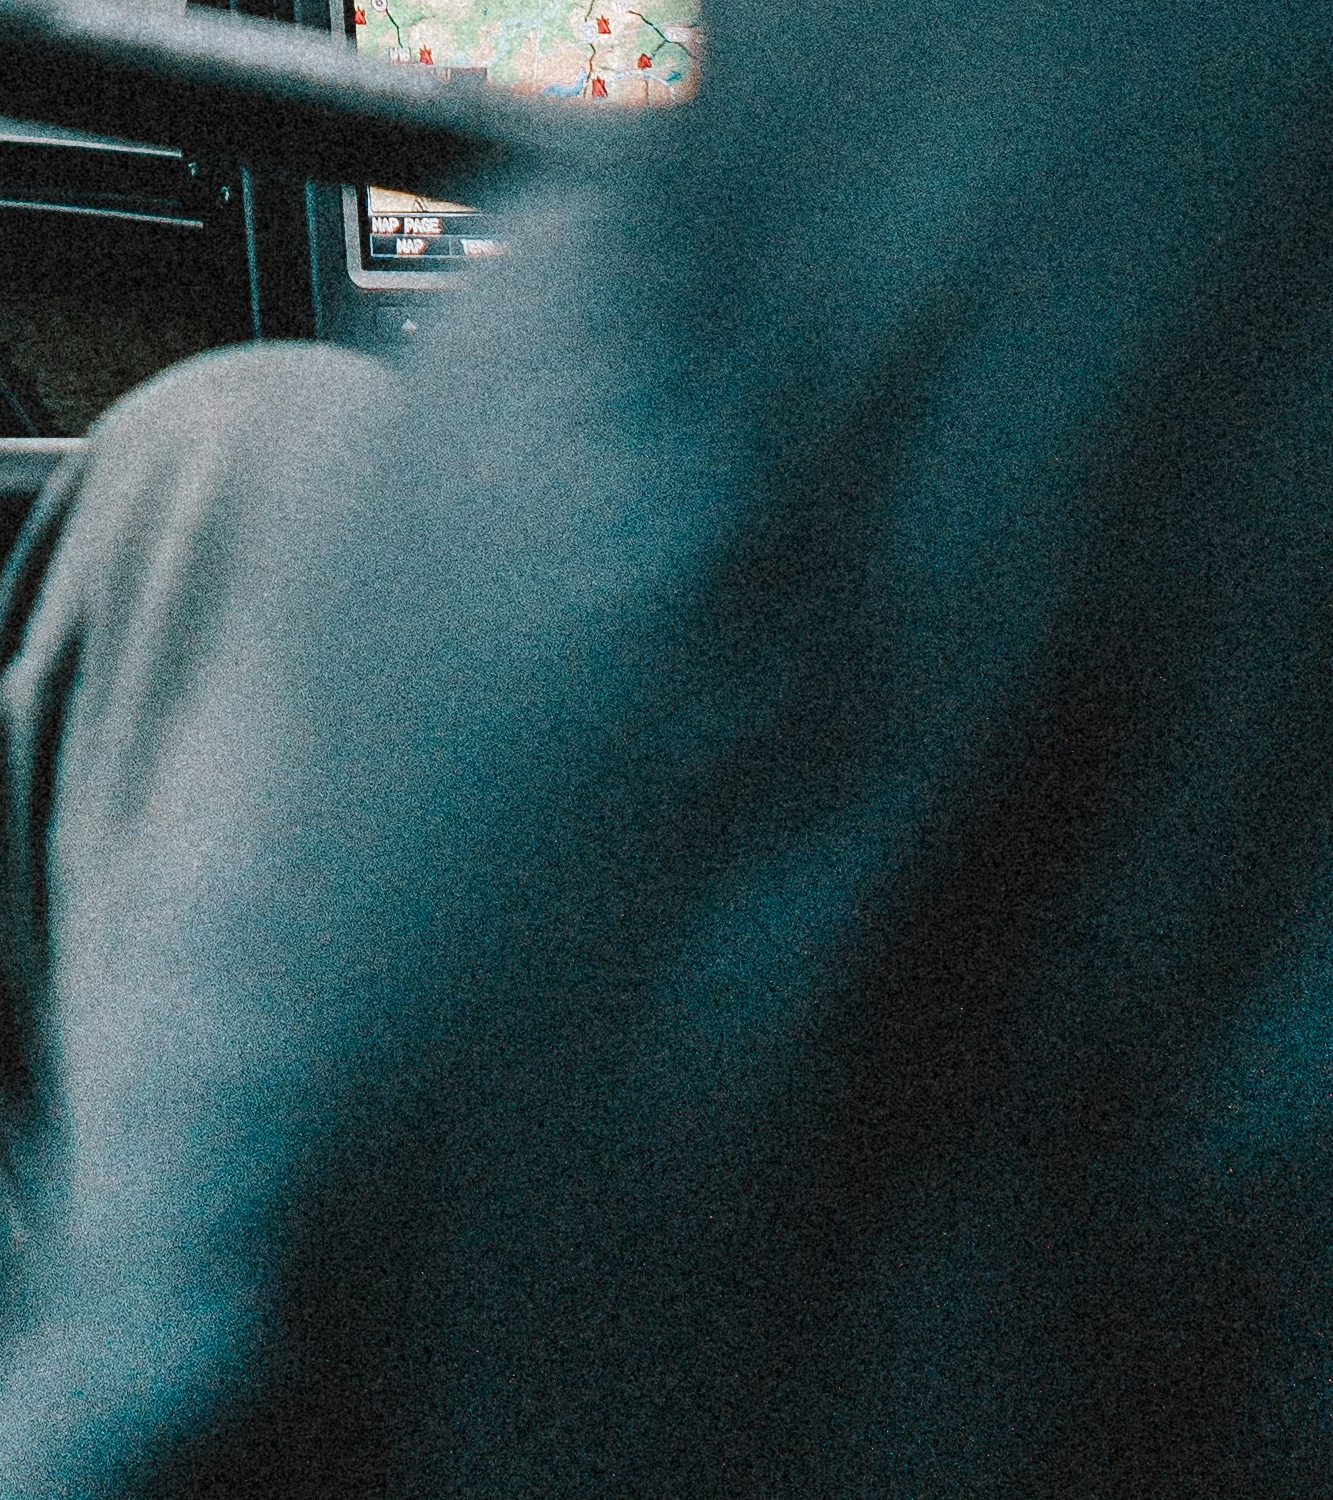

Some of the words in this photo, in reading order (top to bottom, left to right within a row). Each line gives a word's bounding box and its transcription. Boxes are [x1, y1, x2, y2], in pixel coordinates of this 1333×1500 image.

[372, 217, 401, 234] MAP
[403, 217, 443, 234] PAGE
[396, 238, 427, 254] MAP
